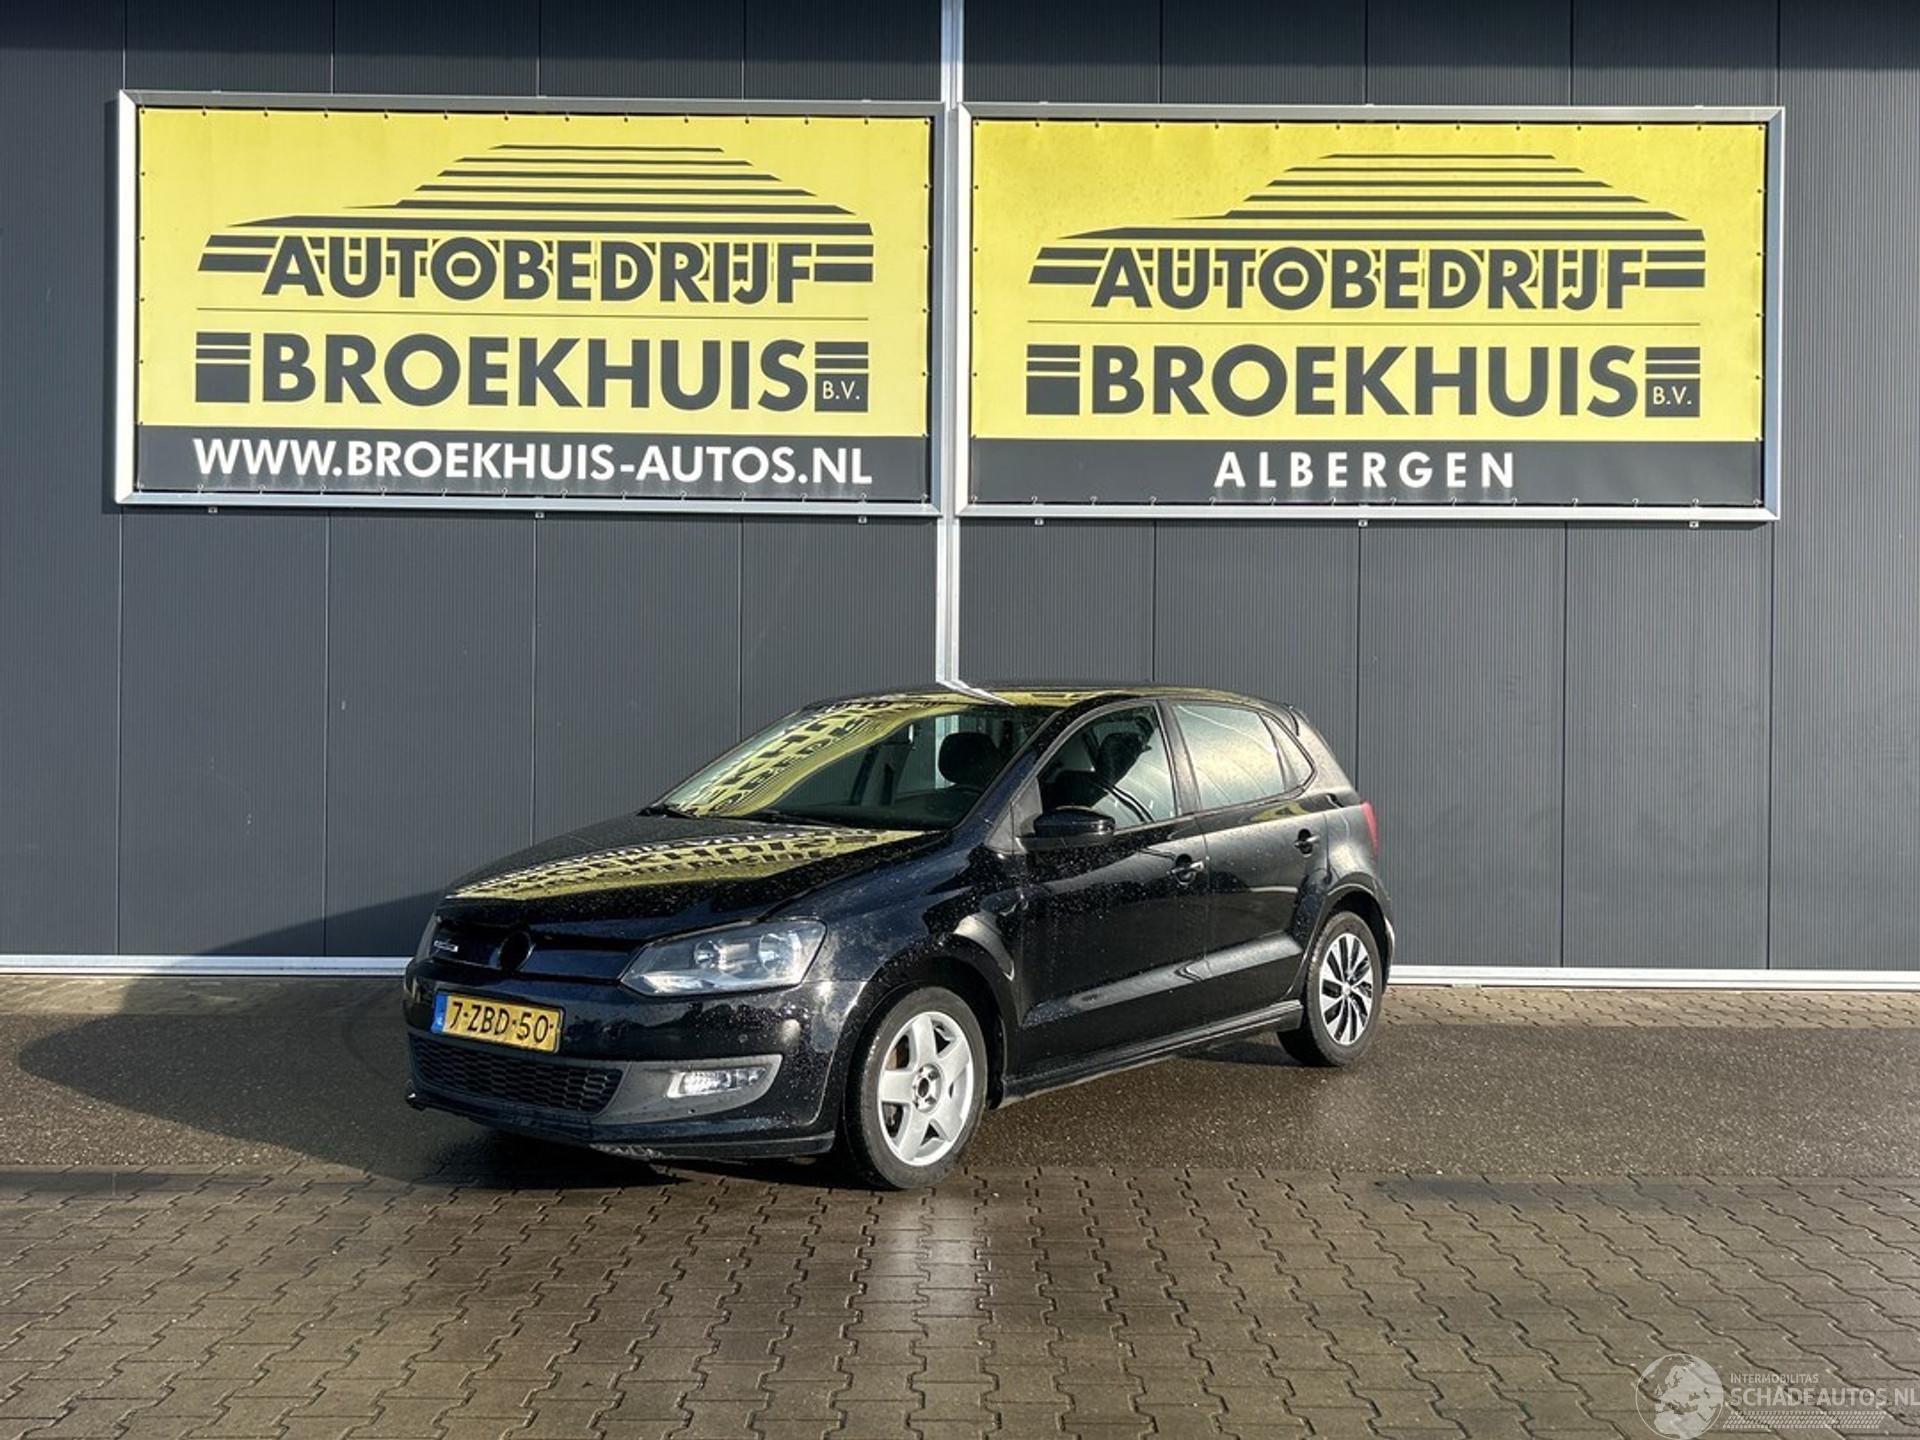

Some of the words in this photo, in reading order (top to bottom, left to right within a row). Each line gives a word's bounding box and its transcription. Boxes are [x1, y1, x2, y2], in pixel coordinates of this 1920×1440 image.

[262, 237, 812, 304] AUTOBEDRIJF
[1091, 246, 1642, 311] AUTOBEDRIJF
[263, 333, 808, 412] BROEKHUIS
[821, 379, 862, 402] B.V.
[1092, 344, 1638, 417] BROEKHUIS
[1651, 385, 1693, 407] B.V.
[194, 438, 872, 485] WWW.BROEKHUIS-AUTOS.NL
[1214, 452, 1515, 488] ALBERGEN
